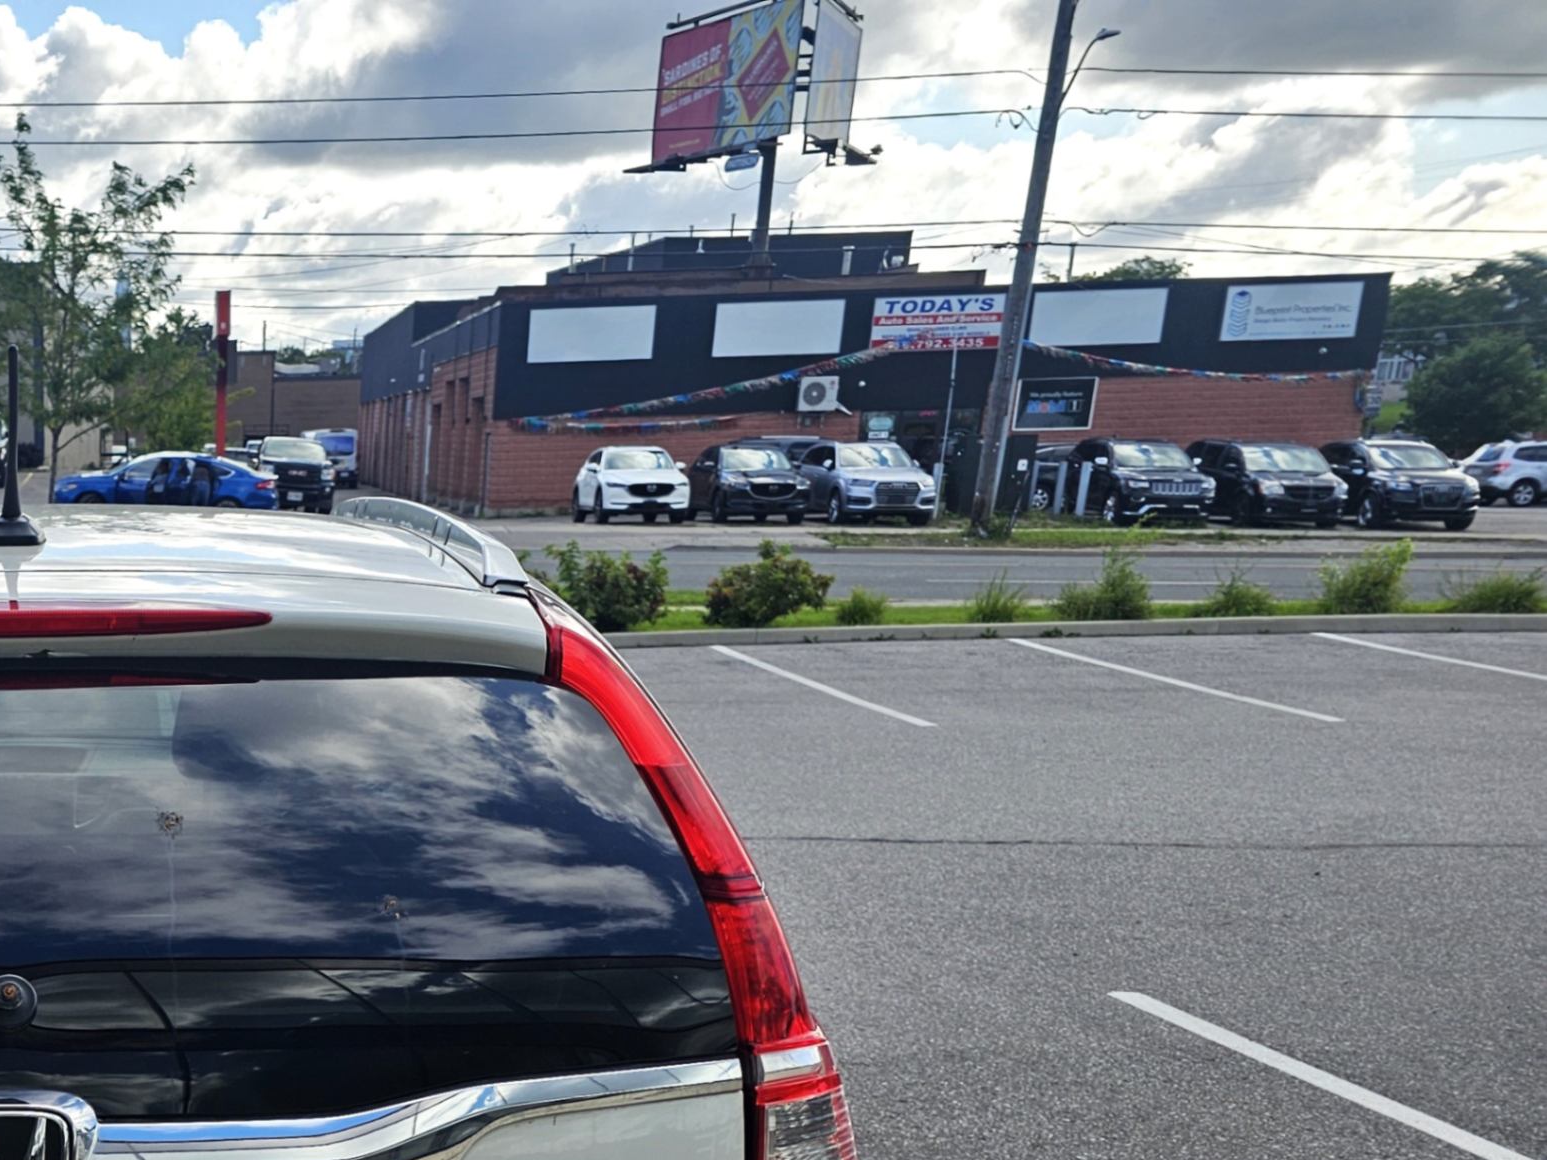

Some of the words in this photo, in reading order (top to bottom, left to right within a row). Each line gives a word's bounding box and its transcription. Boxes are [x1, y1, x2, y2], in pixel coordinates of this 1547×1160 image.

[885, 297, 996, 314] TODAY'S
[878, 317, 903, 325] Auto
[905, 316, 934, 324] Sales
[959, 314, 998, 323] Service
